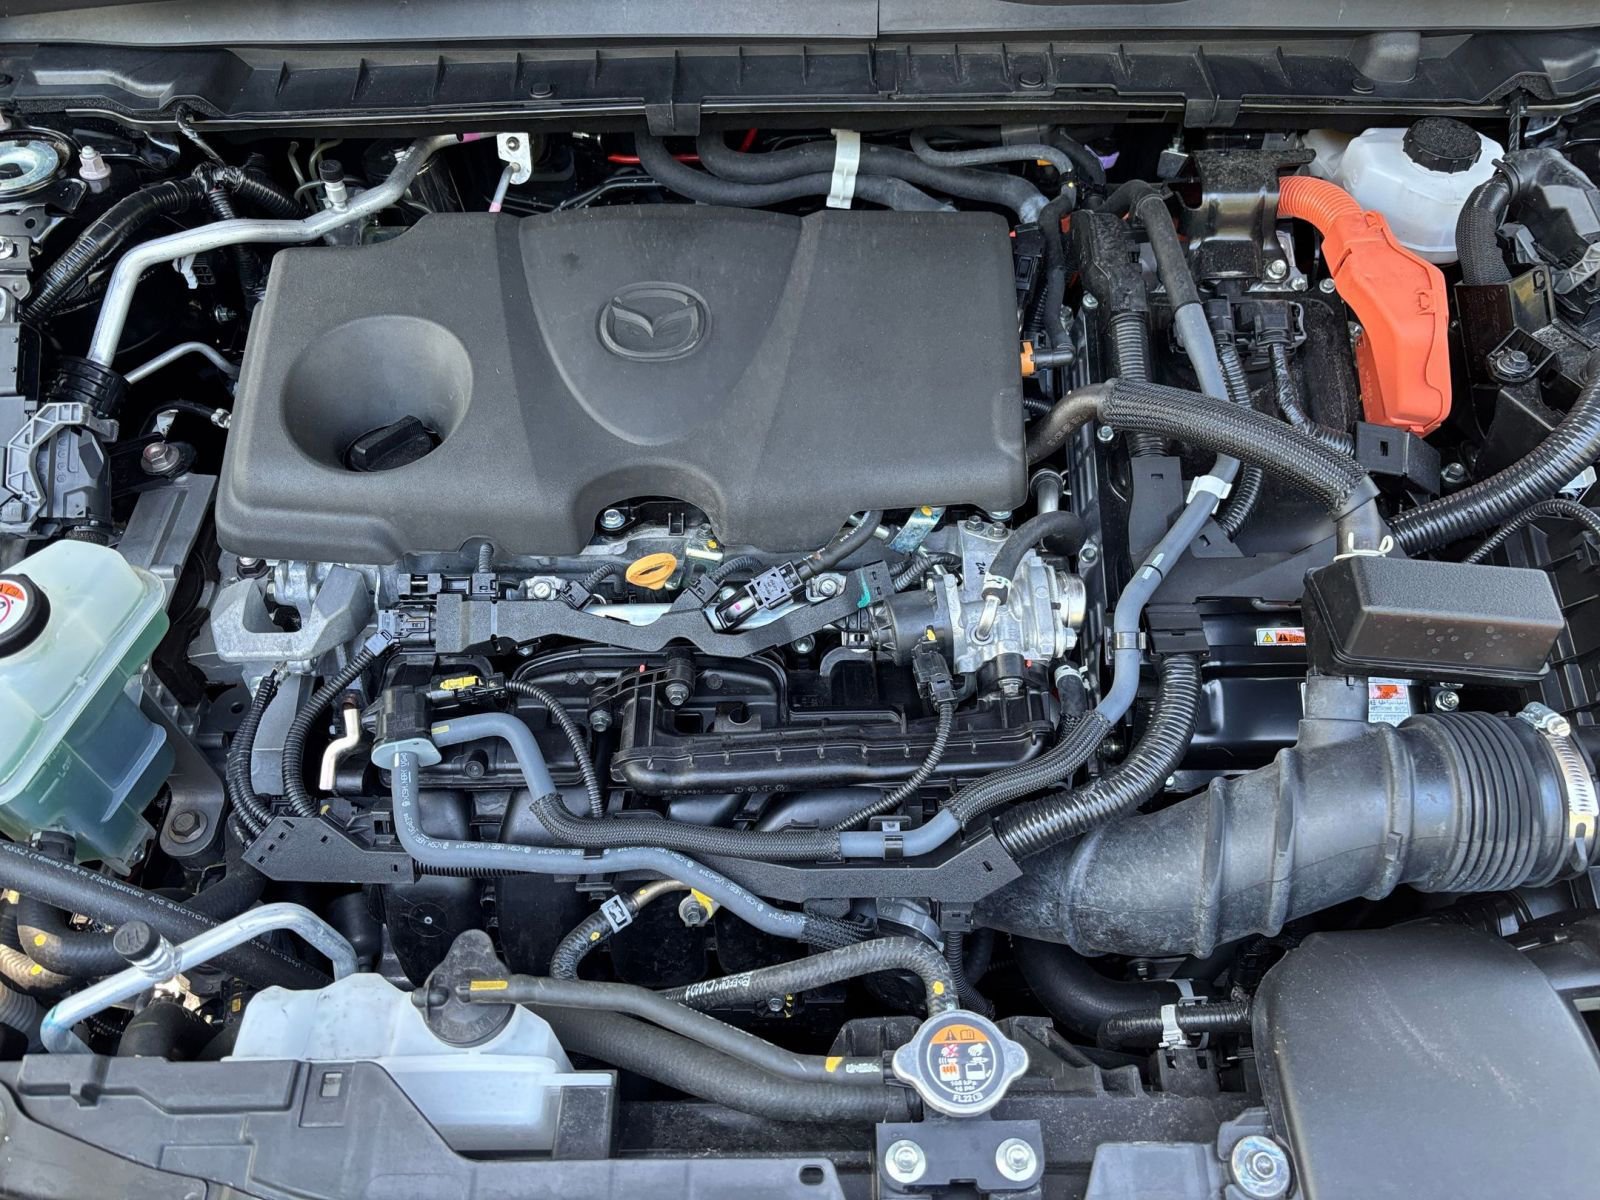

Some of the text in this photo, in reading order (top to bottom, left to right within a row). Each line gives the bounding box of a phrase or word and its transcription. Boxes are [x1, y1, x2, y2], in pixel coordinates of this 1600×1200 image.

[88, 872, 145, 898] Flexbarrier
[148, 894, 166, 906] A/C
[166, 902, 210, 925] SUCTION
[952, 1094, 973, 1102] FL22
